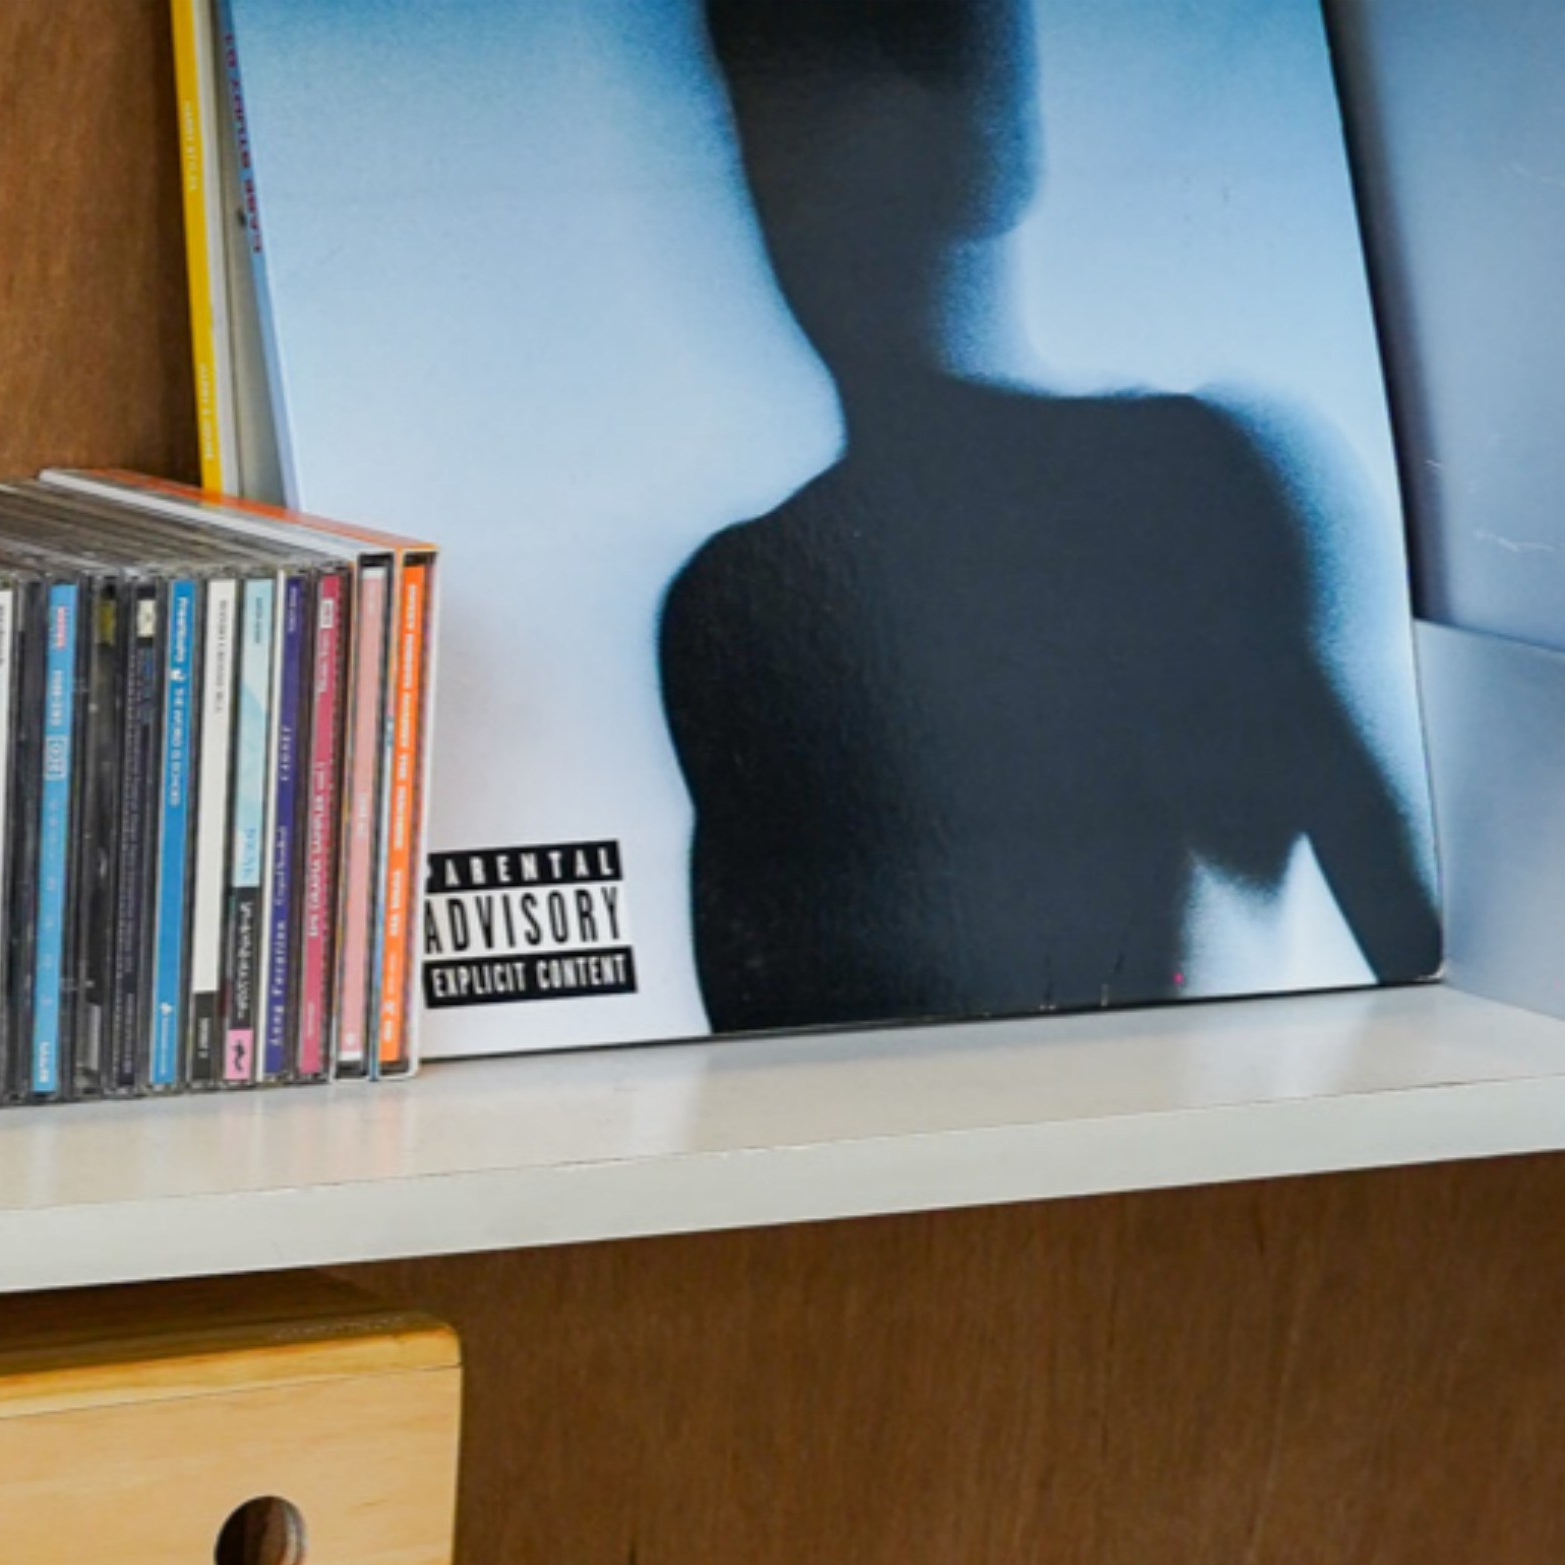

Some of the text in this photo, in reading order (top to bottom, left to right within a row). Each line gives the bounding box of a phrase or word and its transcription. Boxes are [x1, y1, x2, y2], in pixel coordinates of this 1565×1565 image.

[425, 886, 620, 955] ADVISORY
[432, 953, 627, 998] EXPLICIT CONTENT
